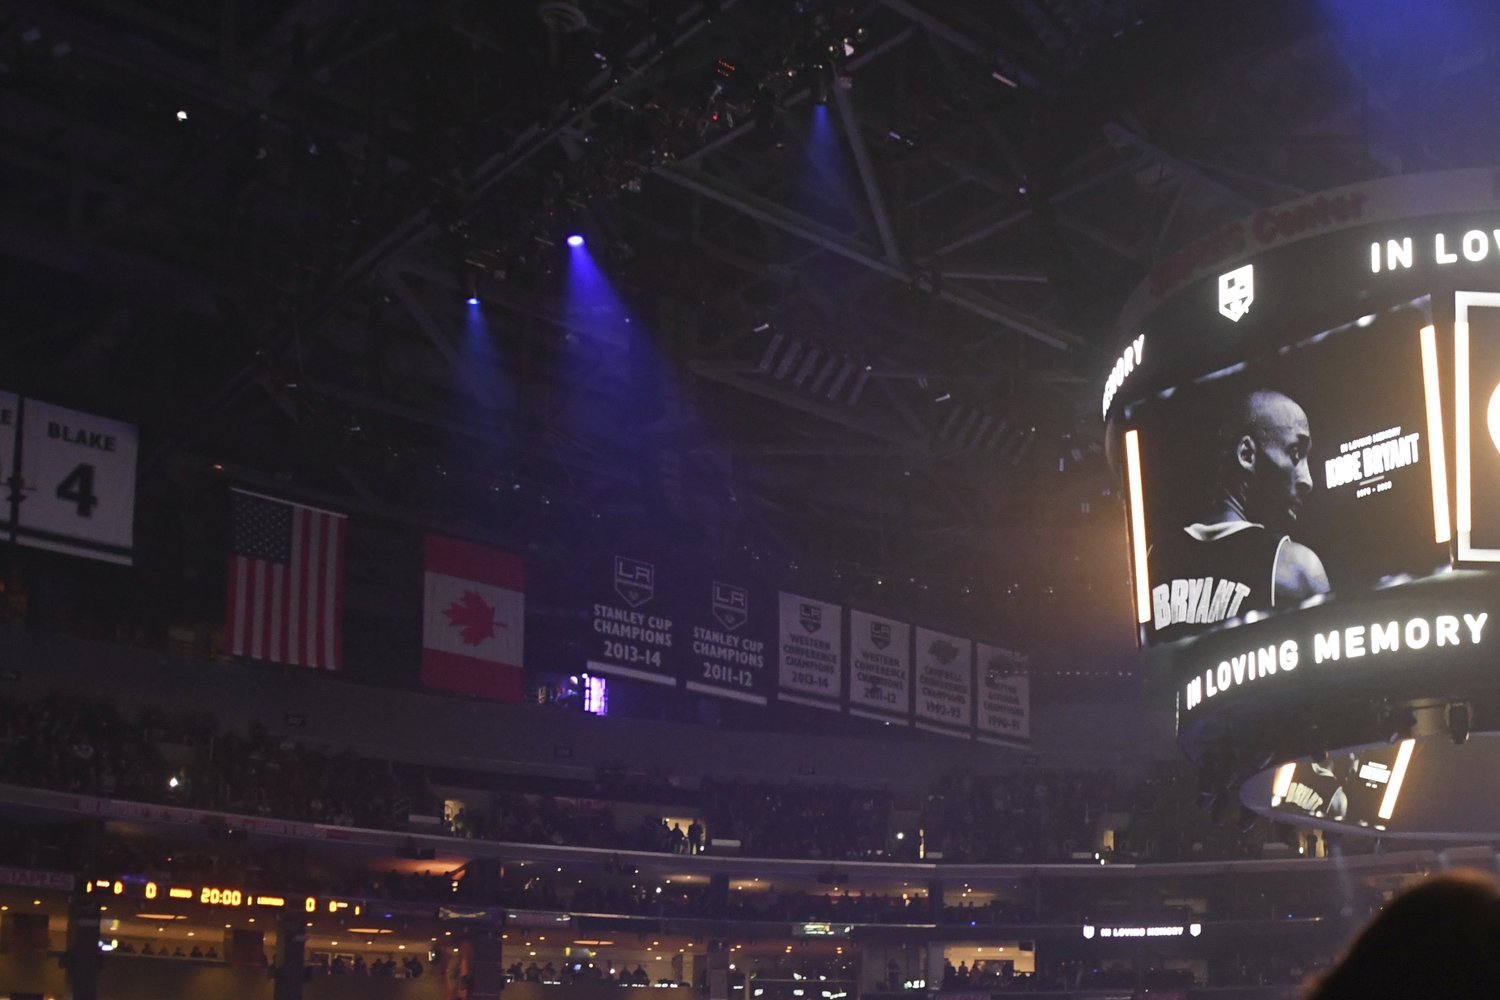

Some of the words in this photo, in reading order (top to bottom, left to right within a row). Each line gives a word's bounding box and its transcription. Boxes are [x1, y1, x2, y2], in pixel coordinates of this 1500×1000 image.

[1371, 237, 1413, 273] IN
[47, 421, 117, 453] BLAKE
[1362, 432, 1419, 477] BRYANT
[55, 462, 98, 518] 4
[618, 562, 650, 582] LA
[716, 587, 745, 606] LA
[1152, 577, 1250, 630] BRYANT
[594, 604, 645, 632] STANLEY
[648, 616, 672, 631] CUP
[593, 618, 672, 647] CHAMPIONS
[693, 626, 740, 648] STANLEY
[742, 639, 764, 653] CUP
[604, 641, 661, 667] 2013-14
[693, 641, 764, 668] CHAMPIONS
[1187, 676, 1201, 710] IN
[1206, 640, 1298, 697] LOVING
[1314, 612, 1488, 664] MEMORY
[703, 662, 753, 687] 2011-12
[201, 887, 242, 906] 20:00
[1113, 927, 1145, 937] LOVING
